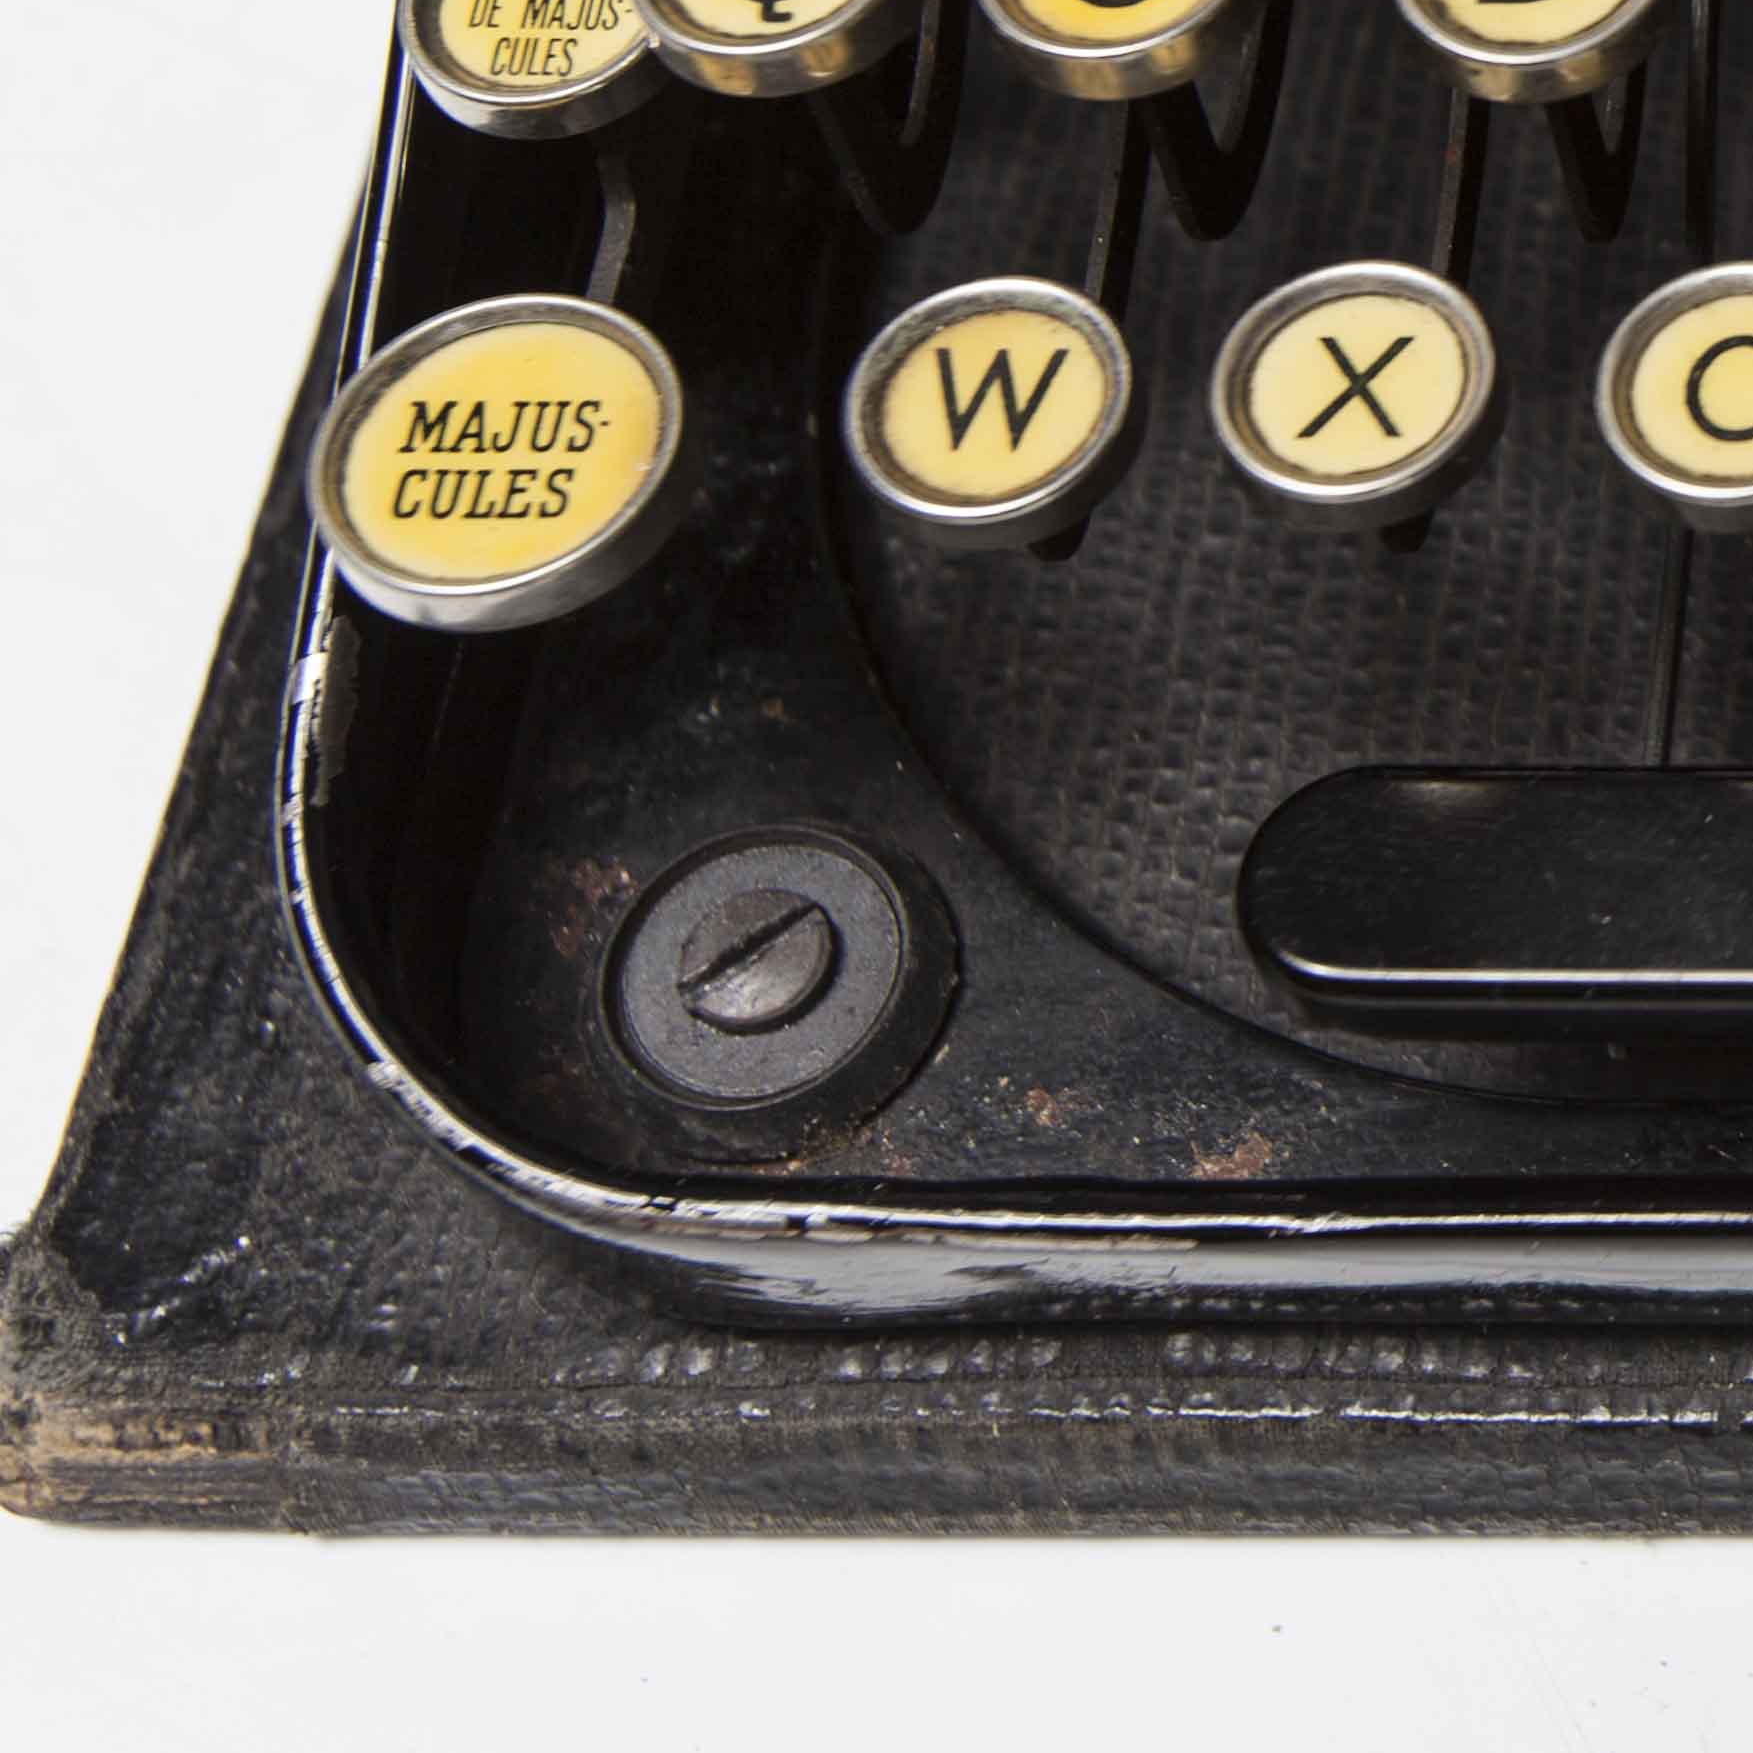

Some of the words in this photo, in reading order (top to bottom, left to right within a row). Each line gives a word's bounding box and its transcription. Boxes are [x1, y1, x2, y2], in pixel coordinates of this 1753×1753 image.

[489, 37, 579, 78] CULES
[935, 347, 1070, 451] W
[1296, 335, 1415, 439] X
[396, 397, 612, 454] MAJUS-
[391, 466, 576, 521] CULES
